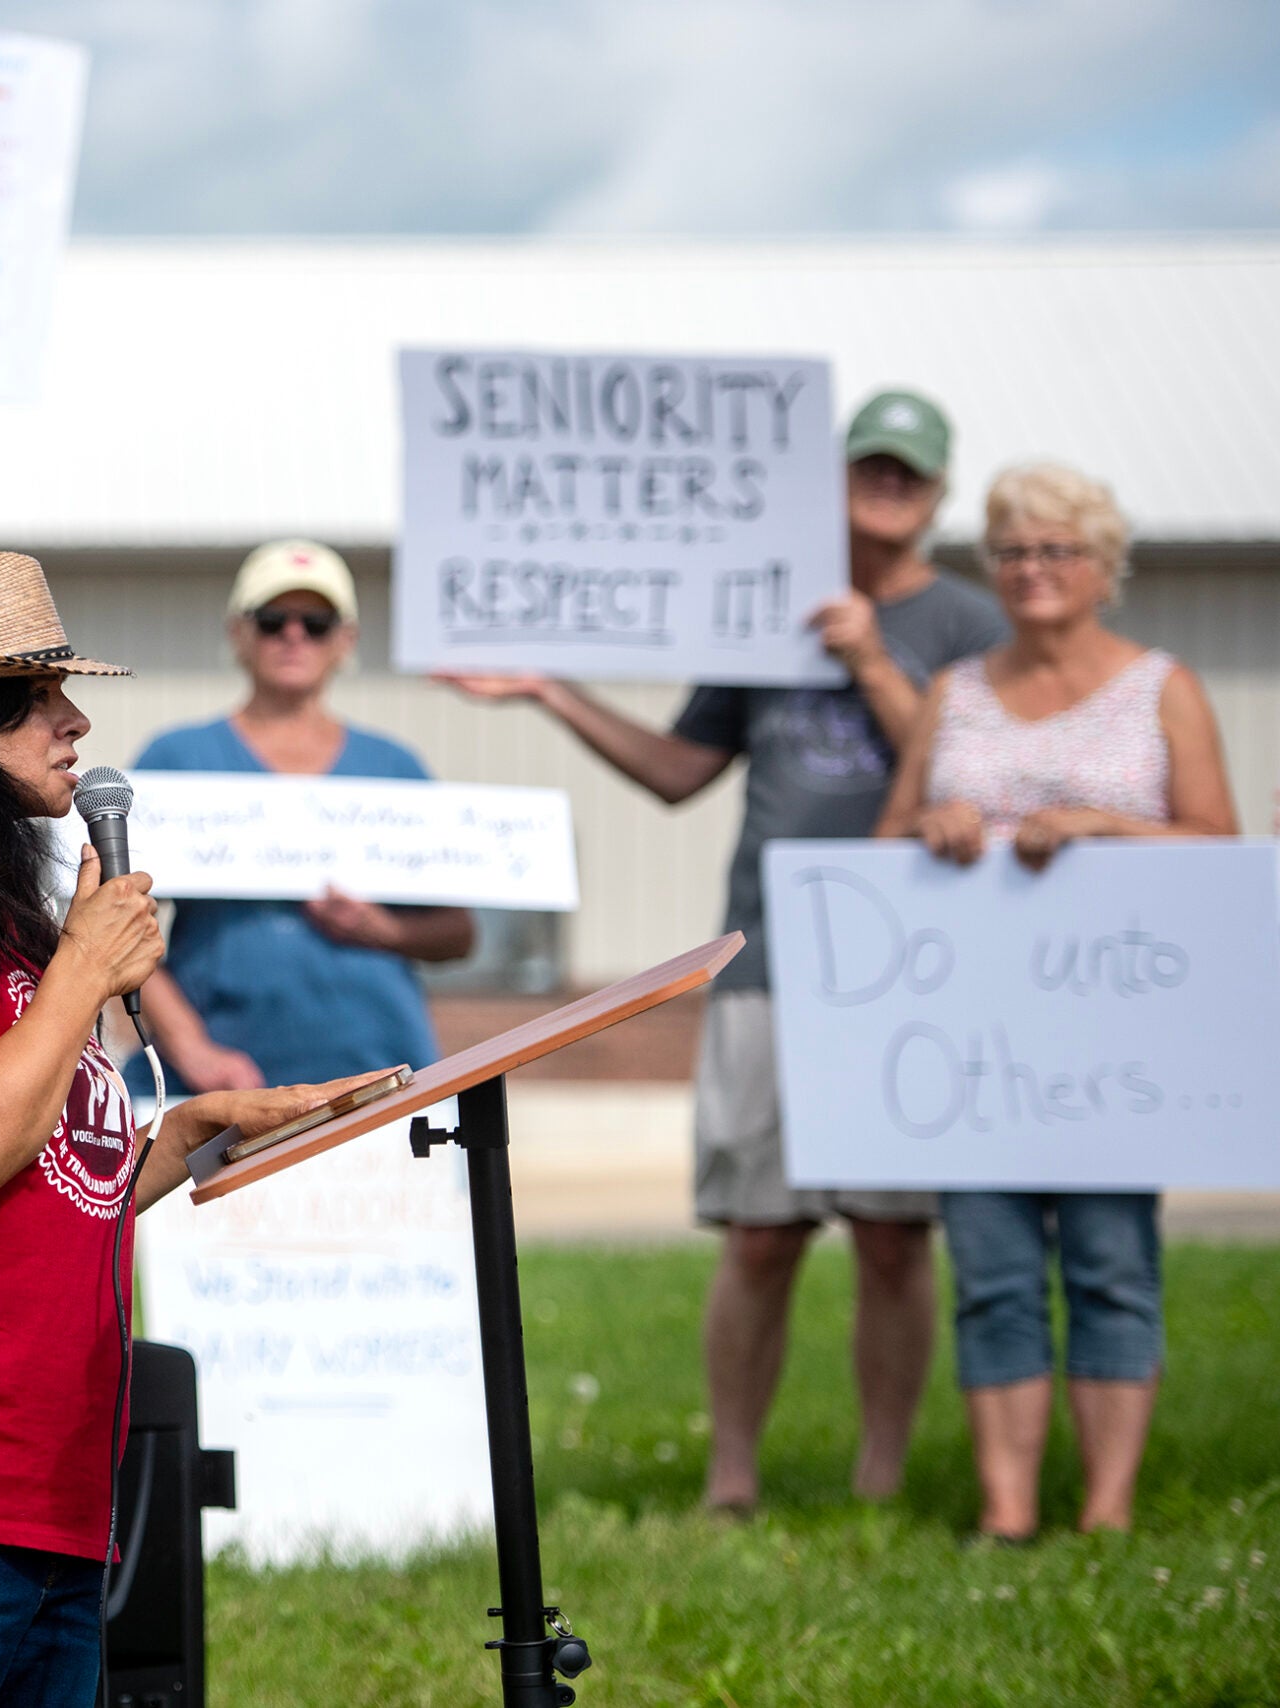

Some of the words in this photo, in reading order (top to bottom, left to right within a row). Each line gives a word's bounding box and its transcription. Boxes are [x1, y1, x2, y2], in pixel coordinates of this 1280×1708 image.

[433, 353, 808, 452] SENIORITY
[460, 452, 767, 521] MATTERS
[438, 556, 682, 632] RESPECT
[791, 865, 955, 1007] Do
[1029, 909, 1190, 998] unto
